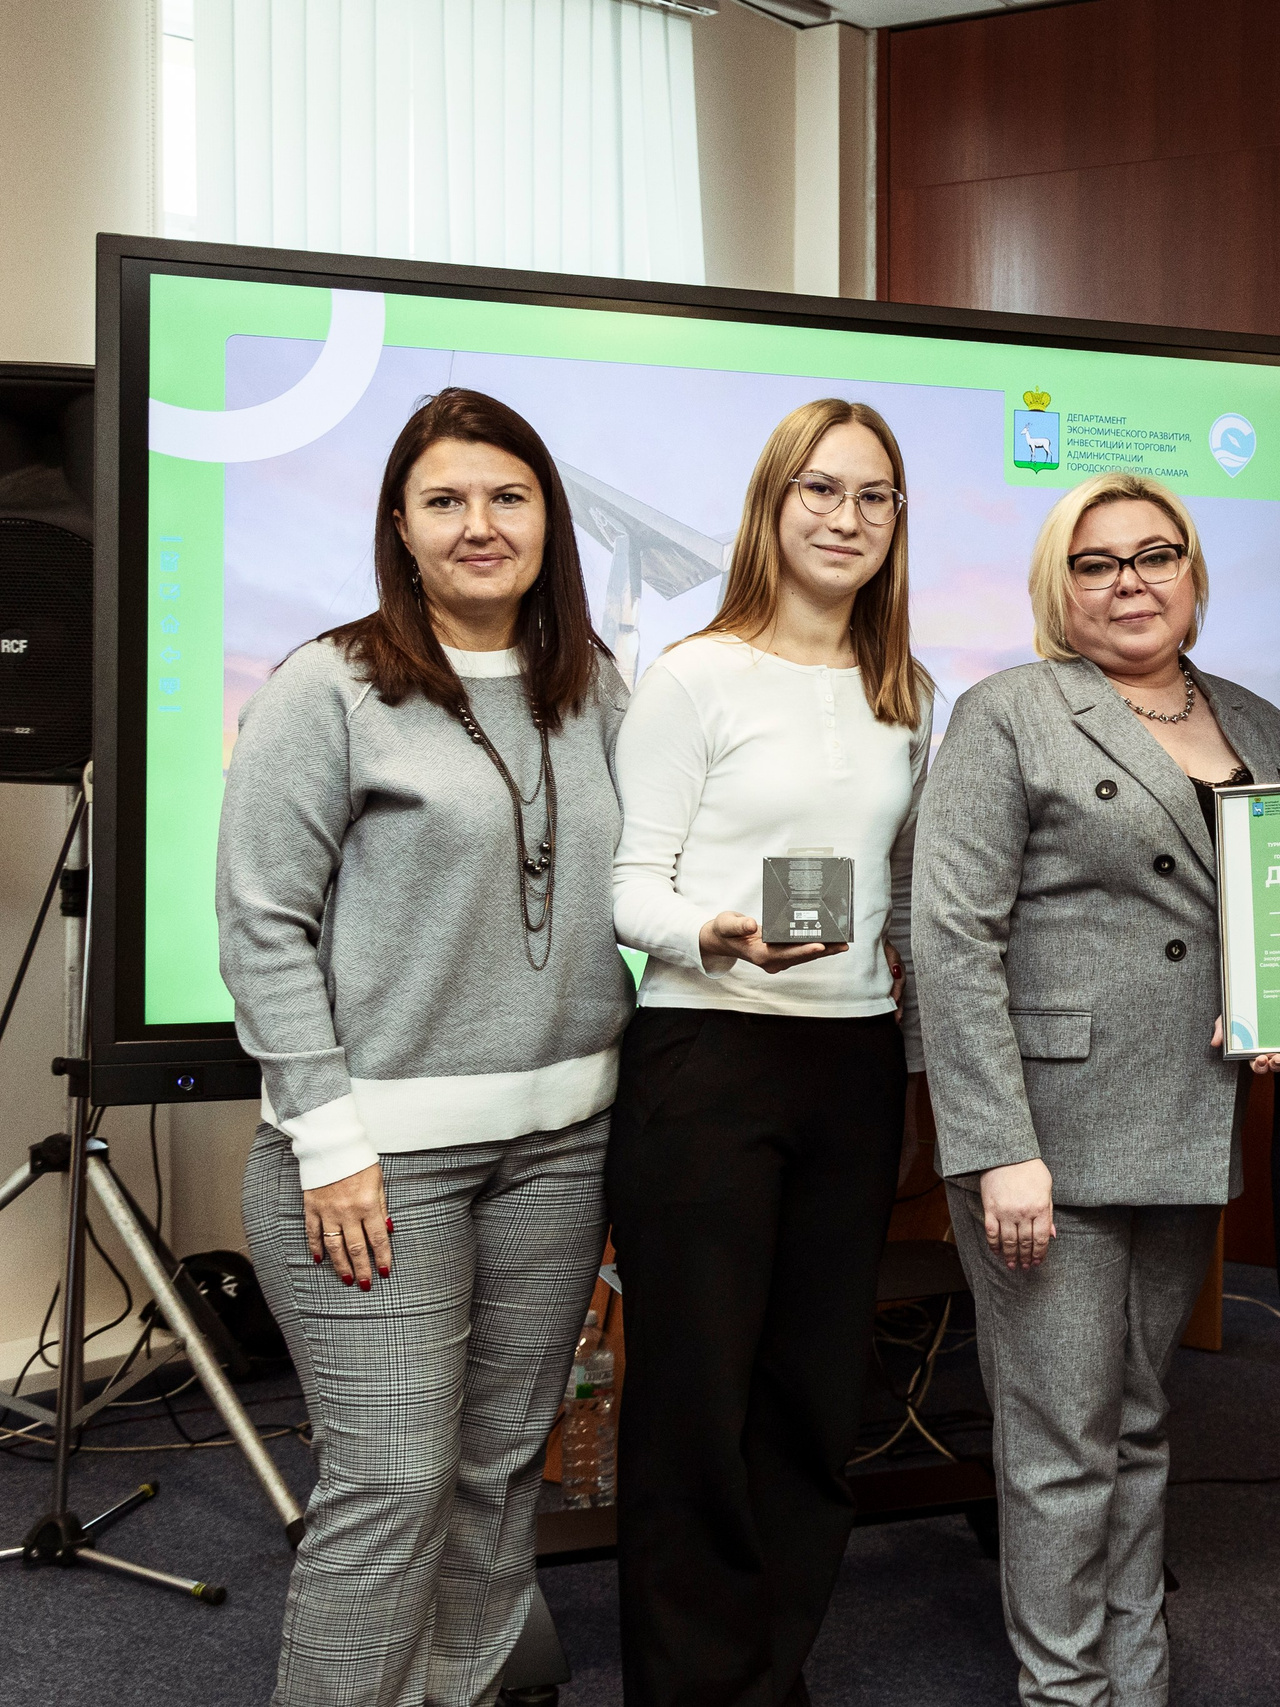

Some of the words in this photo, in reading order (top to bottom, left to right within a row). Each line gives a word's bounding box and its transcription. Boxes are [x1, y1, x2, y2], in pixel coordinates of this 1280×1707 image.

[1066, 413, 1126, 425] ДЕПАРТАМЕНТ
[1066, 426, 1148, 438] ЭКОНОМИЧЕСКОГО
[1149, 431, 1192, 442] РАЗВИТИЯ,
[1066, 438, 1124, 450] ИНВЕСТИЦИЙ
[1126, 442, 1132, 450] И
[1134, 442, 1176, 452] ТОРГОВЛИ
[1066, 450, 1144, 462] АДМИНИСТРАЦИИ
[1066, 462, 1122, 474] ГОРОДСКОГО
[1123, 466, 1154, 476] ОКРУГА
[1155, 468, 1189, 478] САМАРА
[0, 639, 28, 653] RCF
